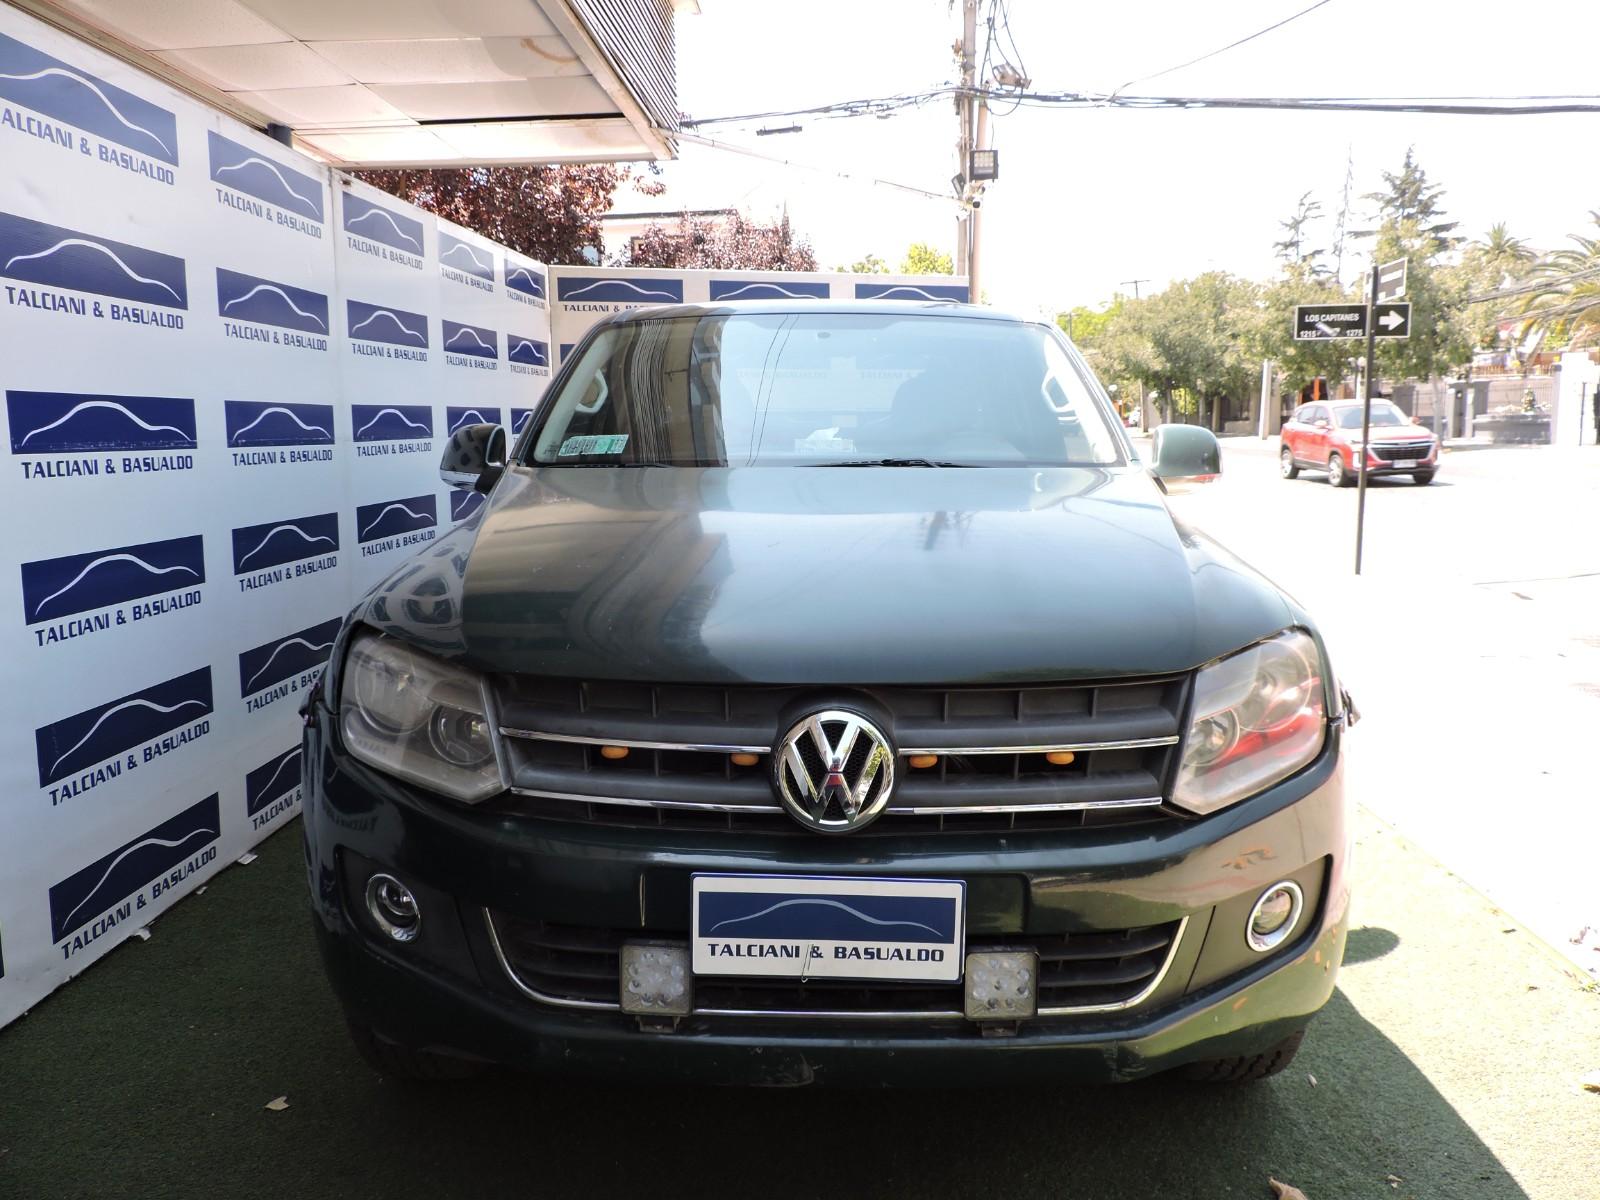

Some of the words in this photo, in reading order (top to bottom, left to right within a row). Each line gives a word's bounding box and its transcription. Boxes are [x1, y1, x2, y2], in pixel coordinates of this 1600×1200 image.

[2, 107, 73, 150] ALCIANI
[80, 135, 92, 157] &
[98, 144, 175, 185] BASUALDO
[216, 188, 263, 218] TALCIANI
[266, 208, 273, 221] &
[277, 212, 322, 239] BASUALDO
[347, 236, 380, 257] TALCIANI
[389, 250, 423, 270] BASUALDO
[442, 267, 463, 285] TALCIANI
[470, 278, 494, 293] BASUALDO
[5, 285, 86, 316] TALCIANI
[93, 301, 104, 318] &
[111, 304, 184, 330] BASUALDO
[563, 304, 609, 312] TALCIANI
[613, 304, 620, 312] &
[1304, 314, 1320, 322] LOS
[1320, 313, 1360, 322] CAPITANES
[224, 323, 270, 344] TALCIANI
[273, 331, 280, 344] &
[283, 333, 327, 352] BASUALDO
[352, 343, 385, 357] TALCIANI
[394, 348, 428, 362] BASUALDO
[446, 355, 469, 367] TALCIANI
[474, 360, 497, 371] BASUALDO
[232, 451, 277, 467] TALCIANI
[290, 449, 333, 463] BASUALDO
[357, 445, 390, 457] TALCIANI
[398, 442, 432, 454] BASUALDO
[22, 459, 99, 479] TALCIANI
[105, 459, 116, 474] &
[122, 455, 194, 473] BASUALDO
[362, 540, 394, 557] TALCIANI
[403, 529, 436, 547] BASUALDO
[239, 569, 282, 592] TALCIANI
[285, 567, 292, 579] &
[296, 556, 337, 577] BASUALDO
[35, 614, 110, 647] TALCIANI
[116, 609, 127, 626] &
[133, 590, 202, 622] BASUALDO
[246, 684, 288, 713] TALCIANI
[291, 680, 298, 692] &
[49, 761, 122, 806] TALCIANI
[127, 754, 138, 770] &
[143, 720, 210, 763] BASUALDO
[252, 794, 293, 830] TALCIANI
[62, 902, 131, 960] TALCIANI
[136, 894, 147, 910] &
[152, 845, 217, 899] BASUALDO
[708, 943, 800, 958] TALCIANI
[810, 945, 824, 958] &
[834, 946, 944, 962] BASUALDO
